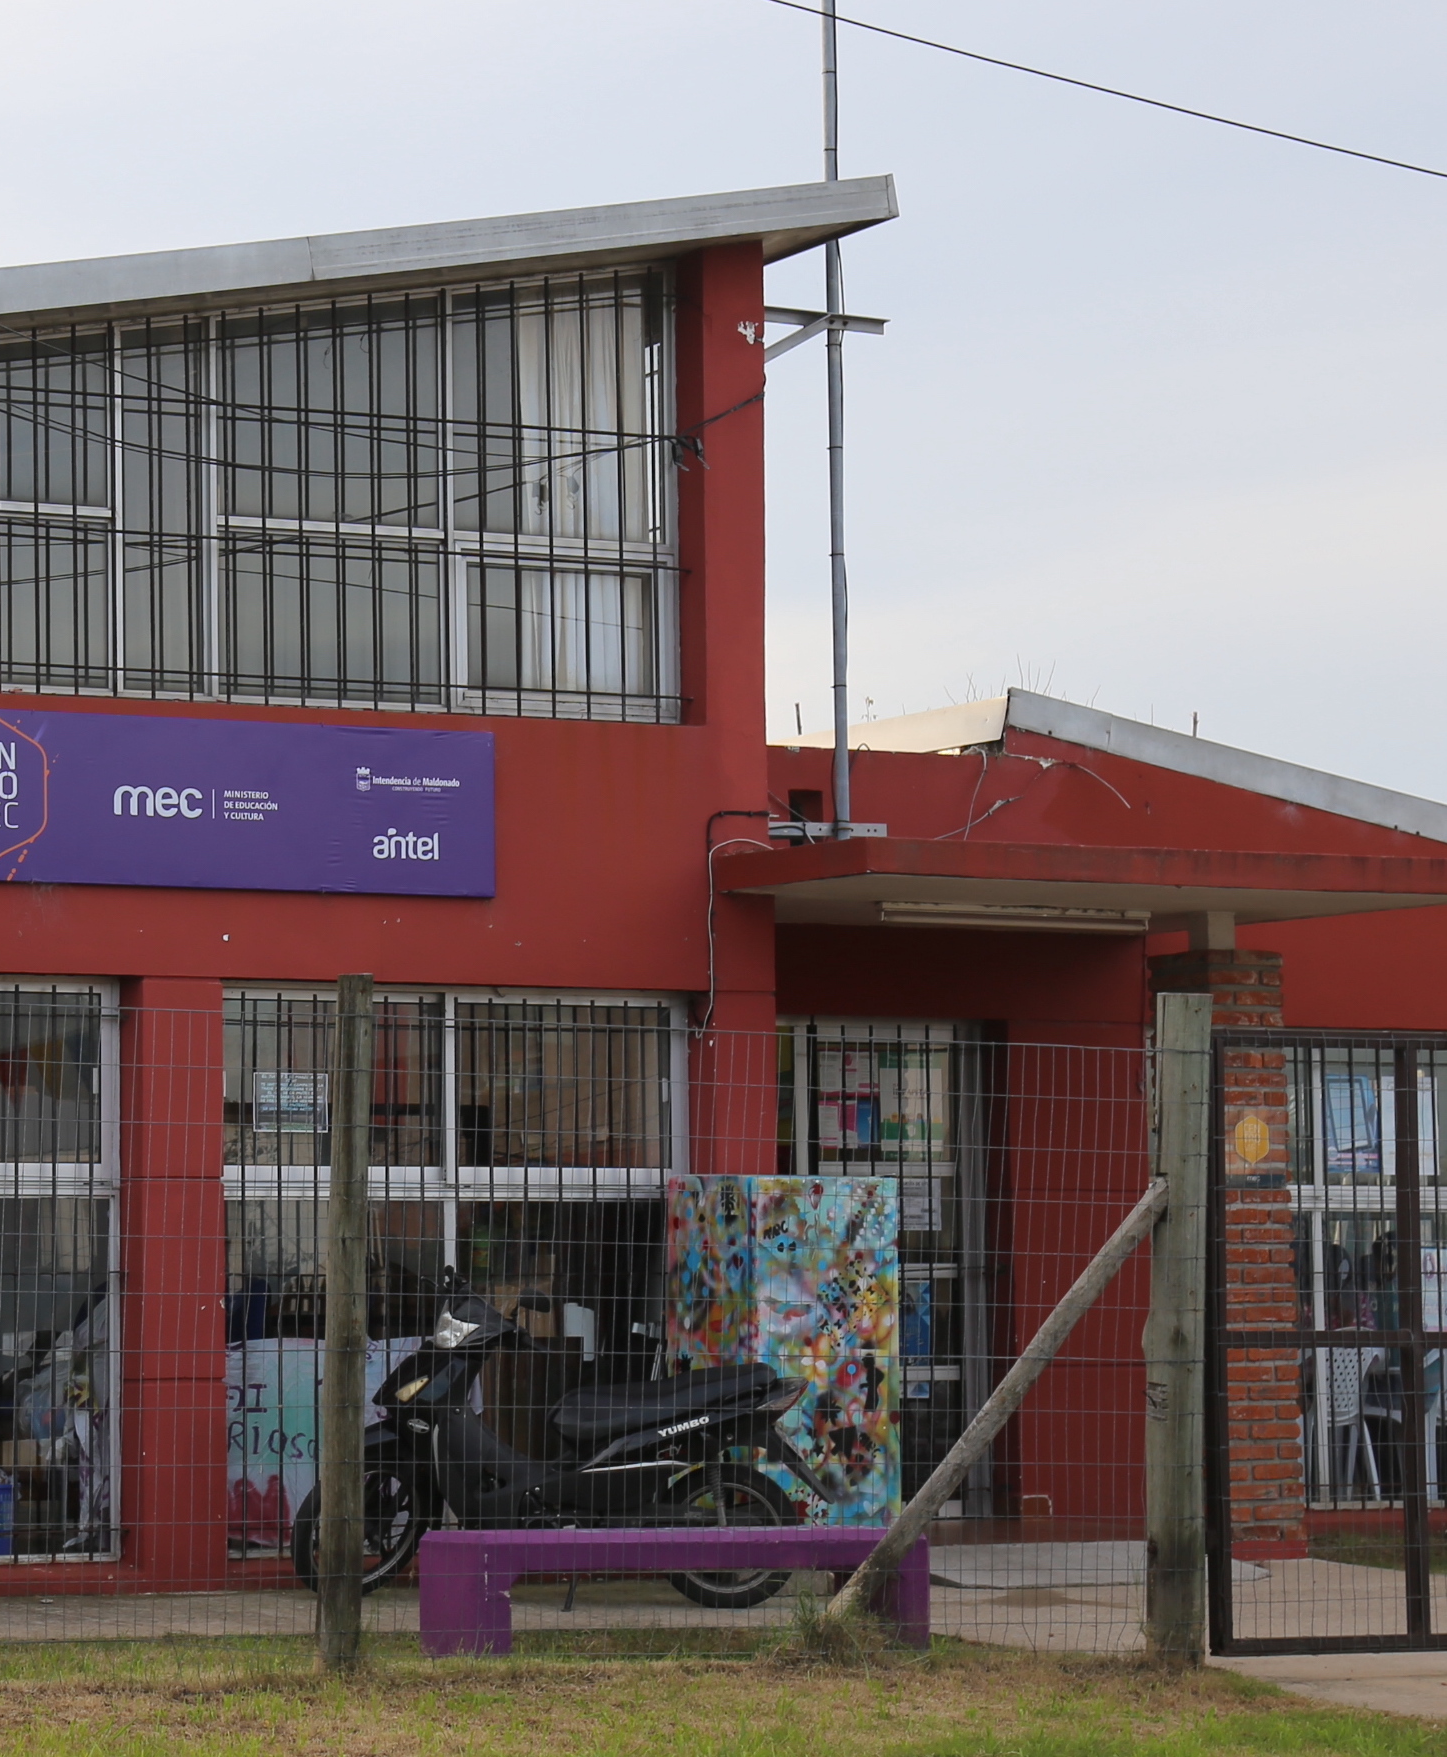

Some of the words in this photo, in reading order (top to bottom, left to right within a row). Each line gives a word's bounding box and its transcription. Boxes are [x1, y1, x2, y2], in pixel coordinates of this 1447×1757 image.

[372, 775, 411, 786] Intendencia
[412, 778, 421, 786] de
[422, 778, 460, 788] Maldonado
[223, 790, 269, 800] MINISTERIO
[113, 785, 203, 819] mec
[223, 801, 234, 809] DE
[235, 800, 278, 811] EDUCACIÓN
[223, 812, 229, 820] Y
[230, 812, 264, 821] CULTURA
[657, 1415, 710, 1437] YUMBO
